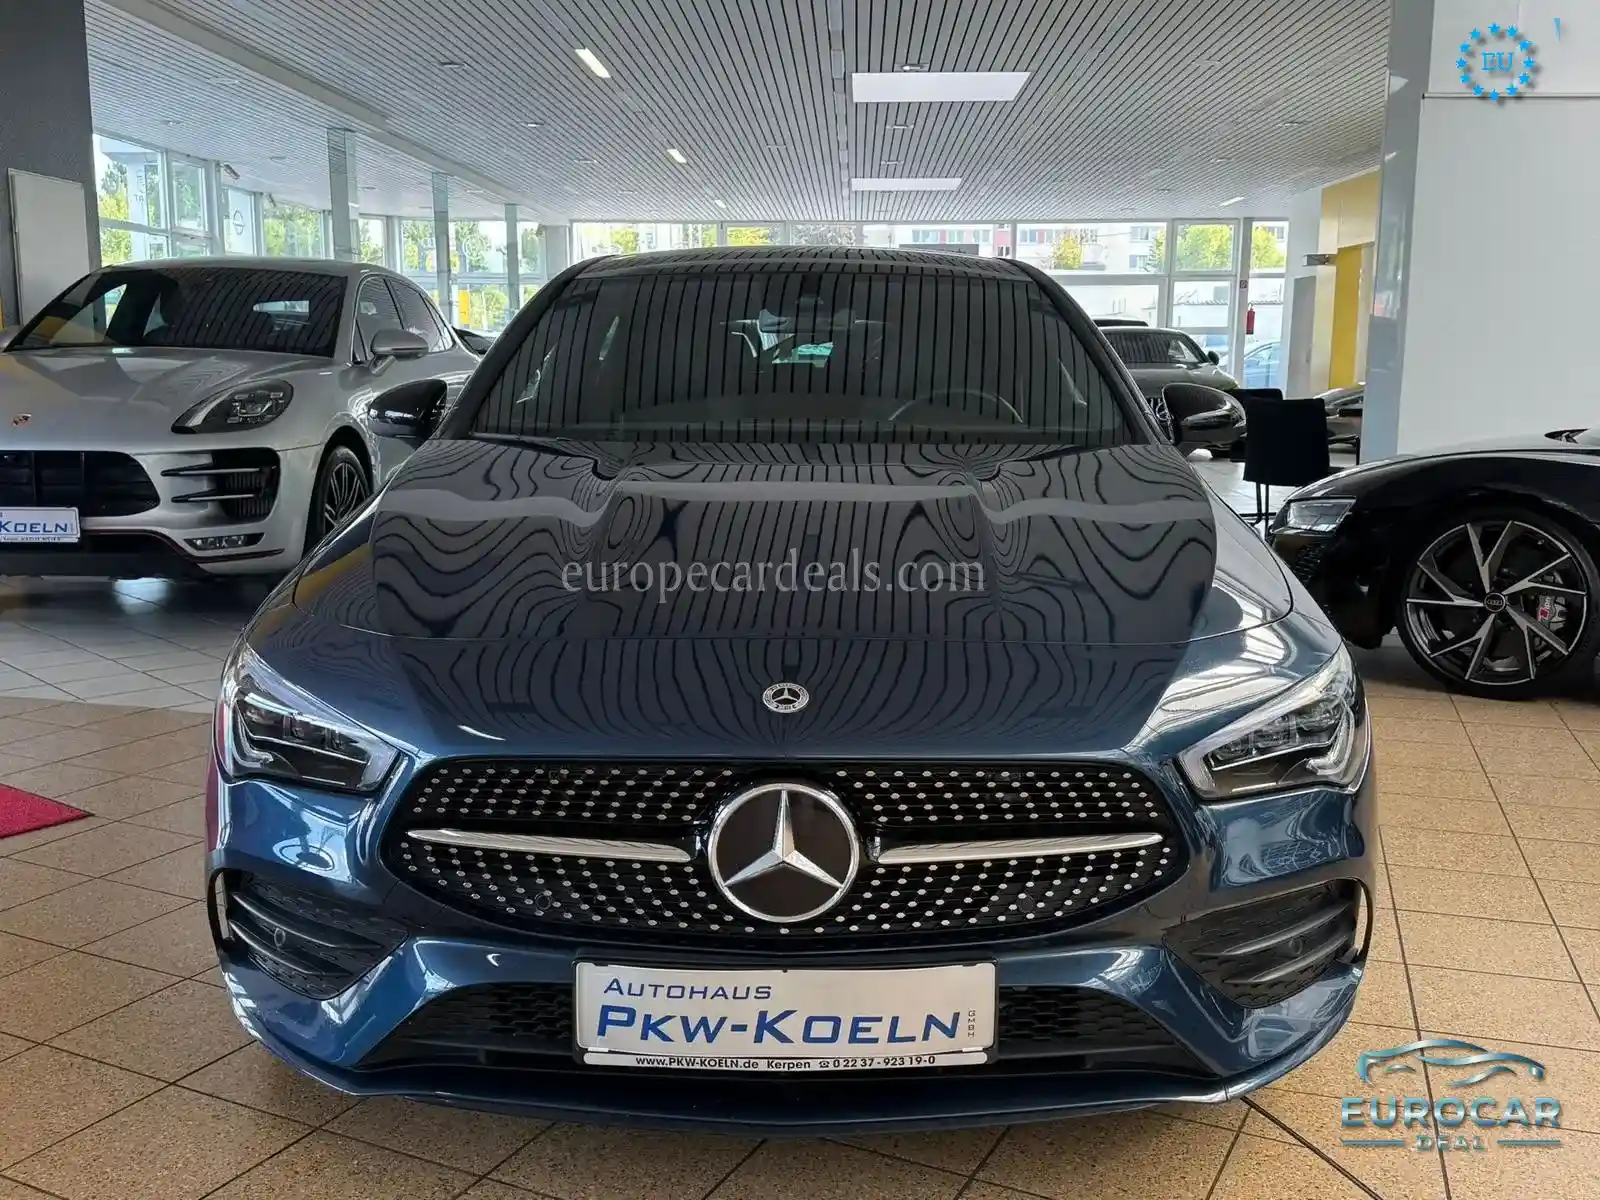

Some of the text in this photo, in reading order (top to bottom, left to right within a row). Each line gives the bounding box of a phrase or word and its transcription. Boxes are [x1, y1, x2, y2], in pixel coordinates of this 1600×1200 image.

[603, 977, 772, 1000] AUTOHAUS
[597, 1004, 961, 1044] PKW-KOELN
[635, 1056, 759, 1069] www.PKW-KOELN.de
[767, 1060, 811, 1070] Kerpen
